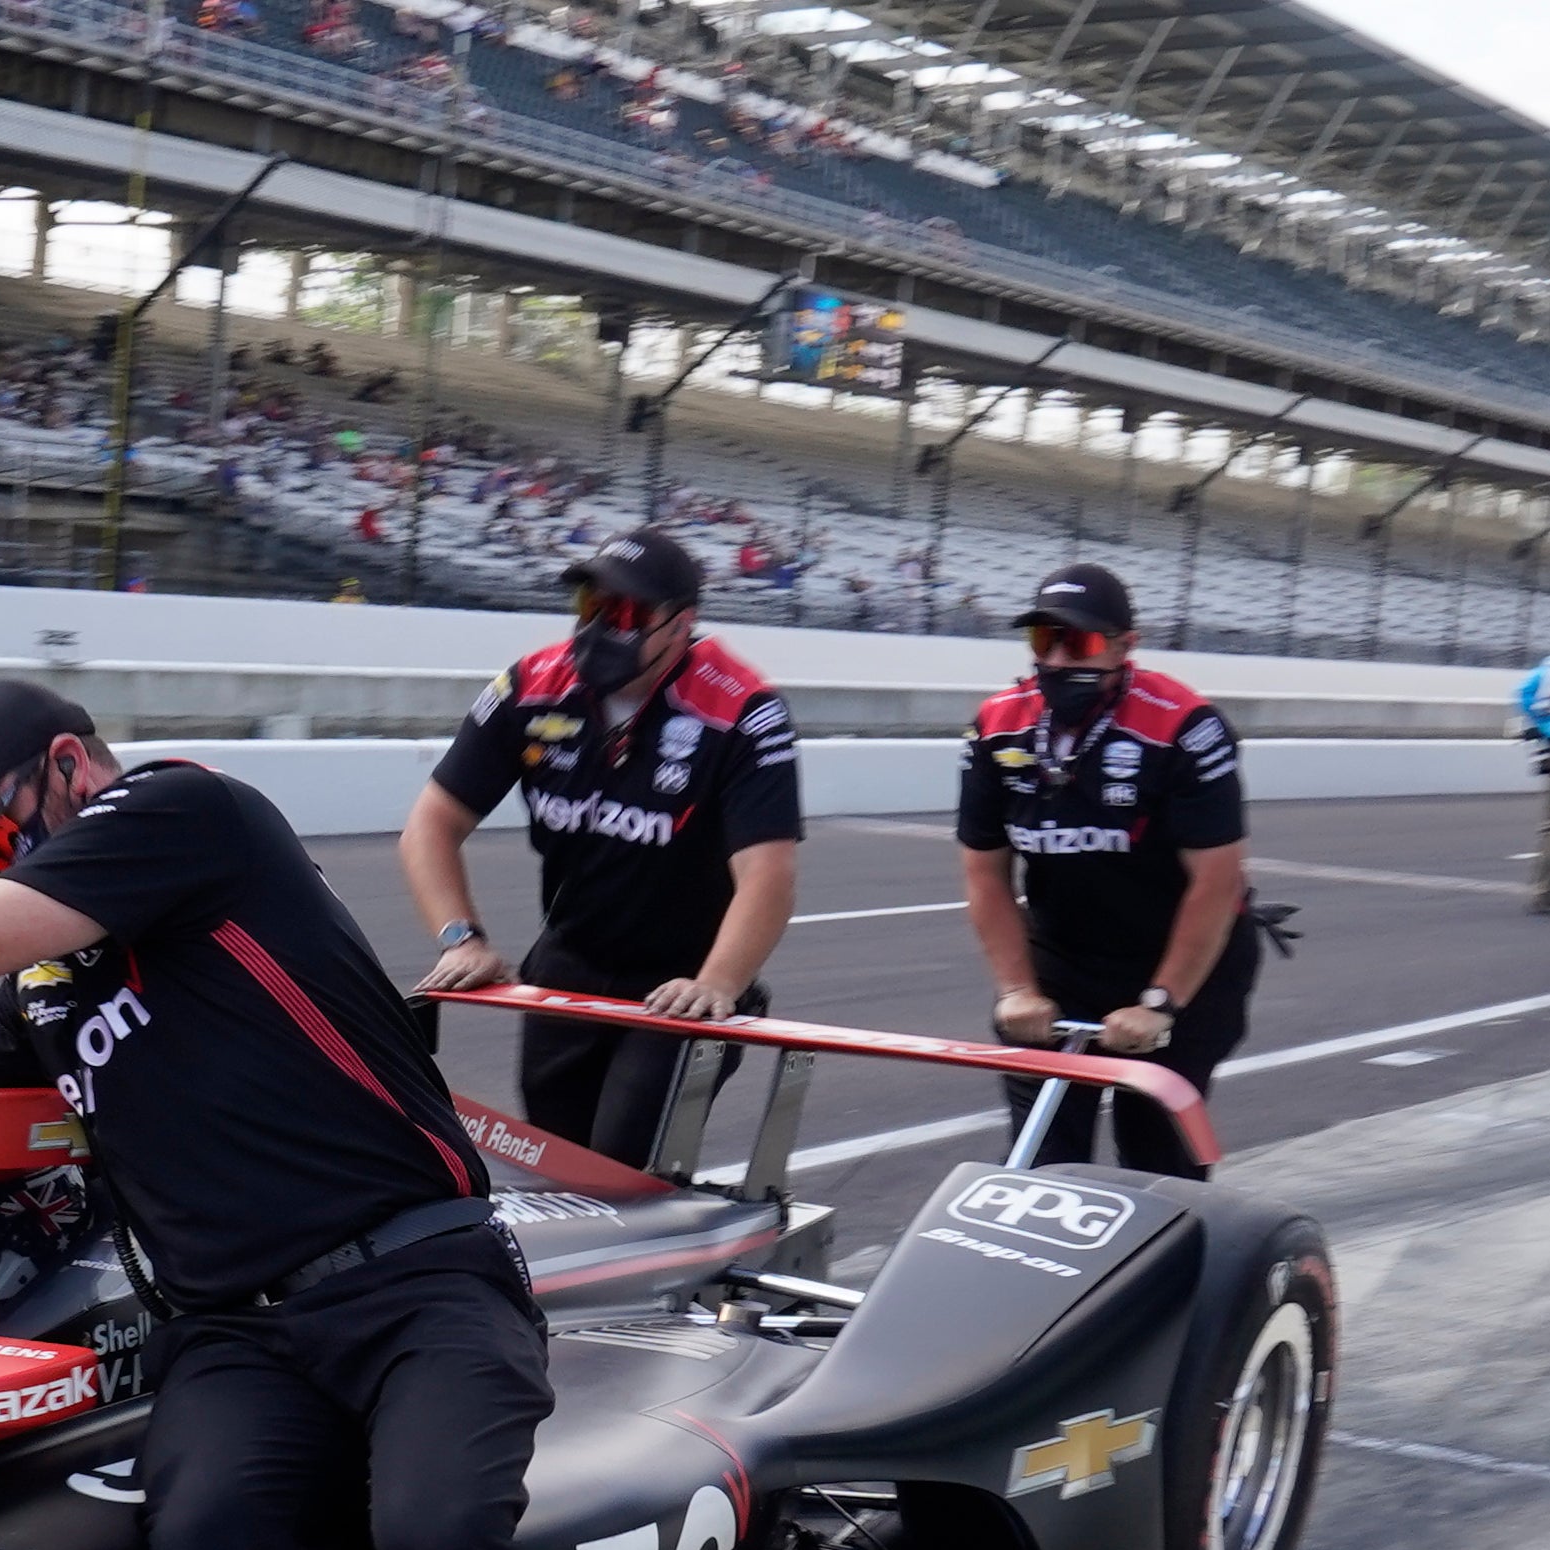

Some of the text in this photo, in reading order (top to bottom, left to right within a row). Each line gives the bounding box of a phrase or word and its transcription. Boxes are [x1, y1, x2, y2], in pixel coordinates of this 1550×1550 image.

[526, 787, 674, 847] verizon
[485, 1121, 547, 1167] Rental
[961, 1183, 1119, 1238] PPG
[92, 1311, 151, 1356] Shell
